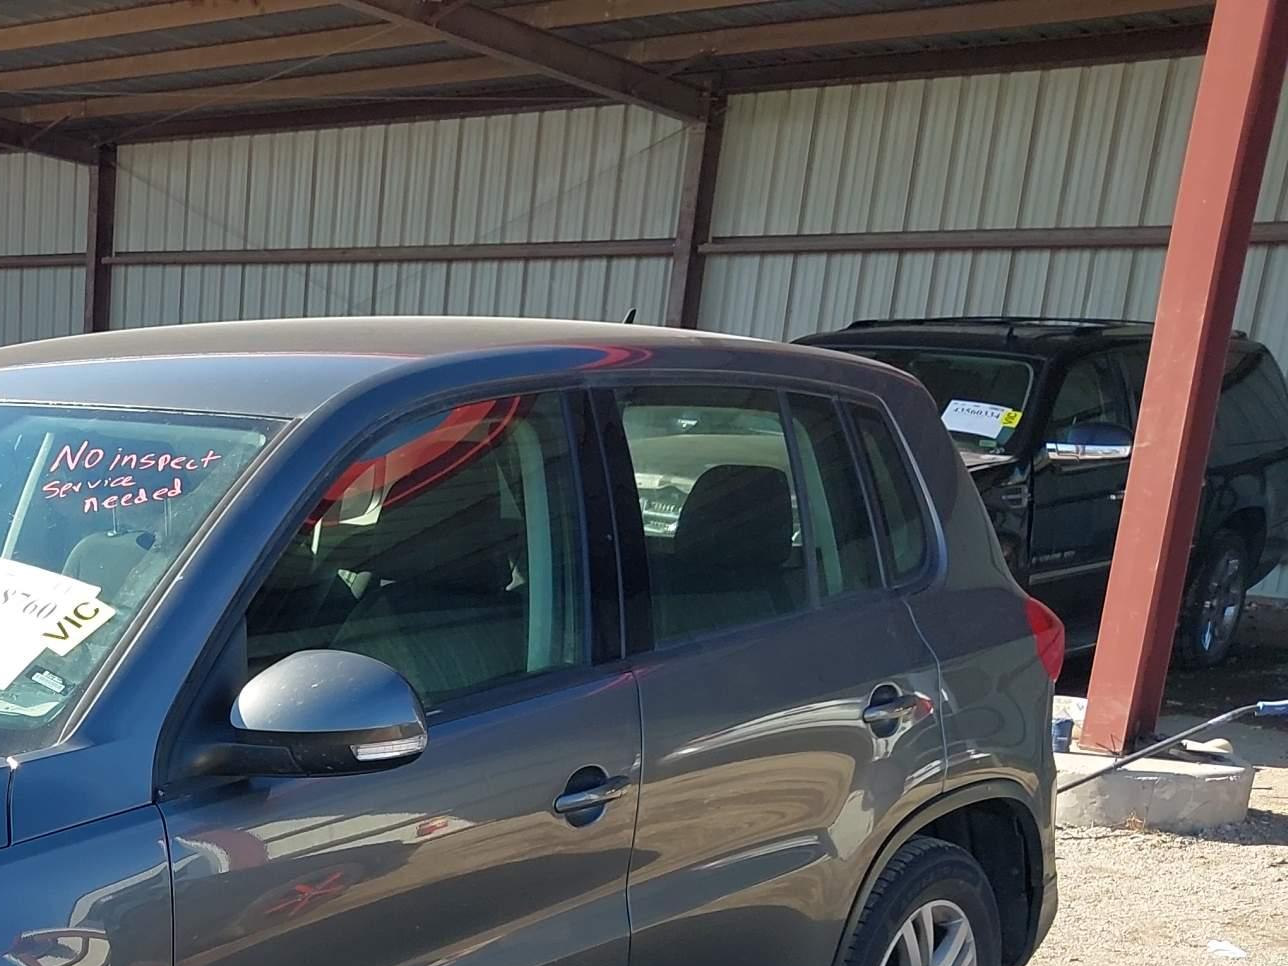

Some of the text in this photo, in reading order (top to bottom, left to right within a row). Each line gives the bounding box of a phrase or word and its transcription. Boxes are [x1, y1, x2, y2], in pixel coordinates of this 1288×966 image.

[108, 447, 223, 473] inspect
[83, 478, 184, 514] needed
[42, 601, 100, 641] VIC
